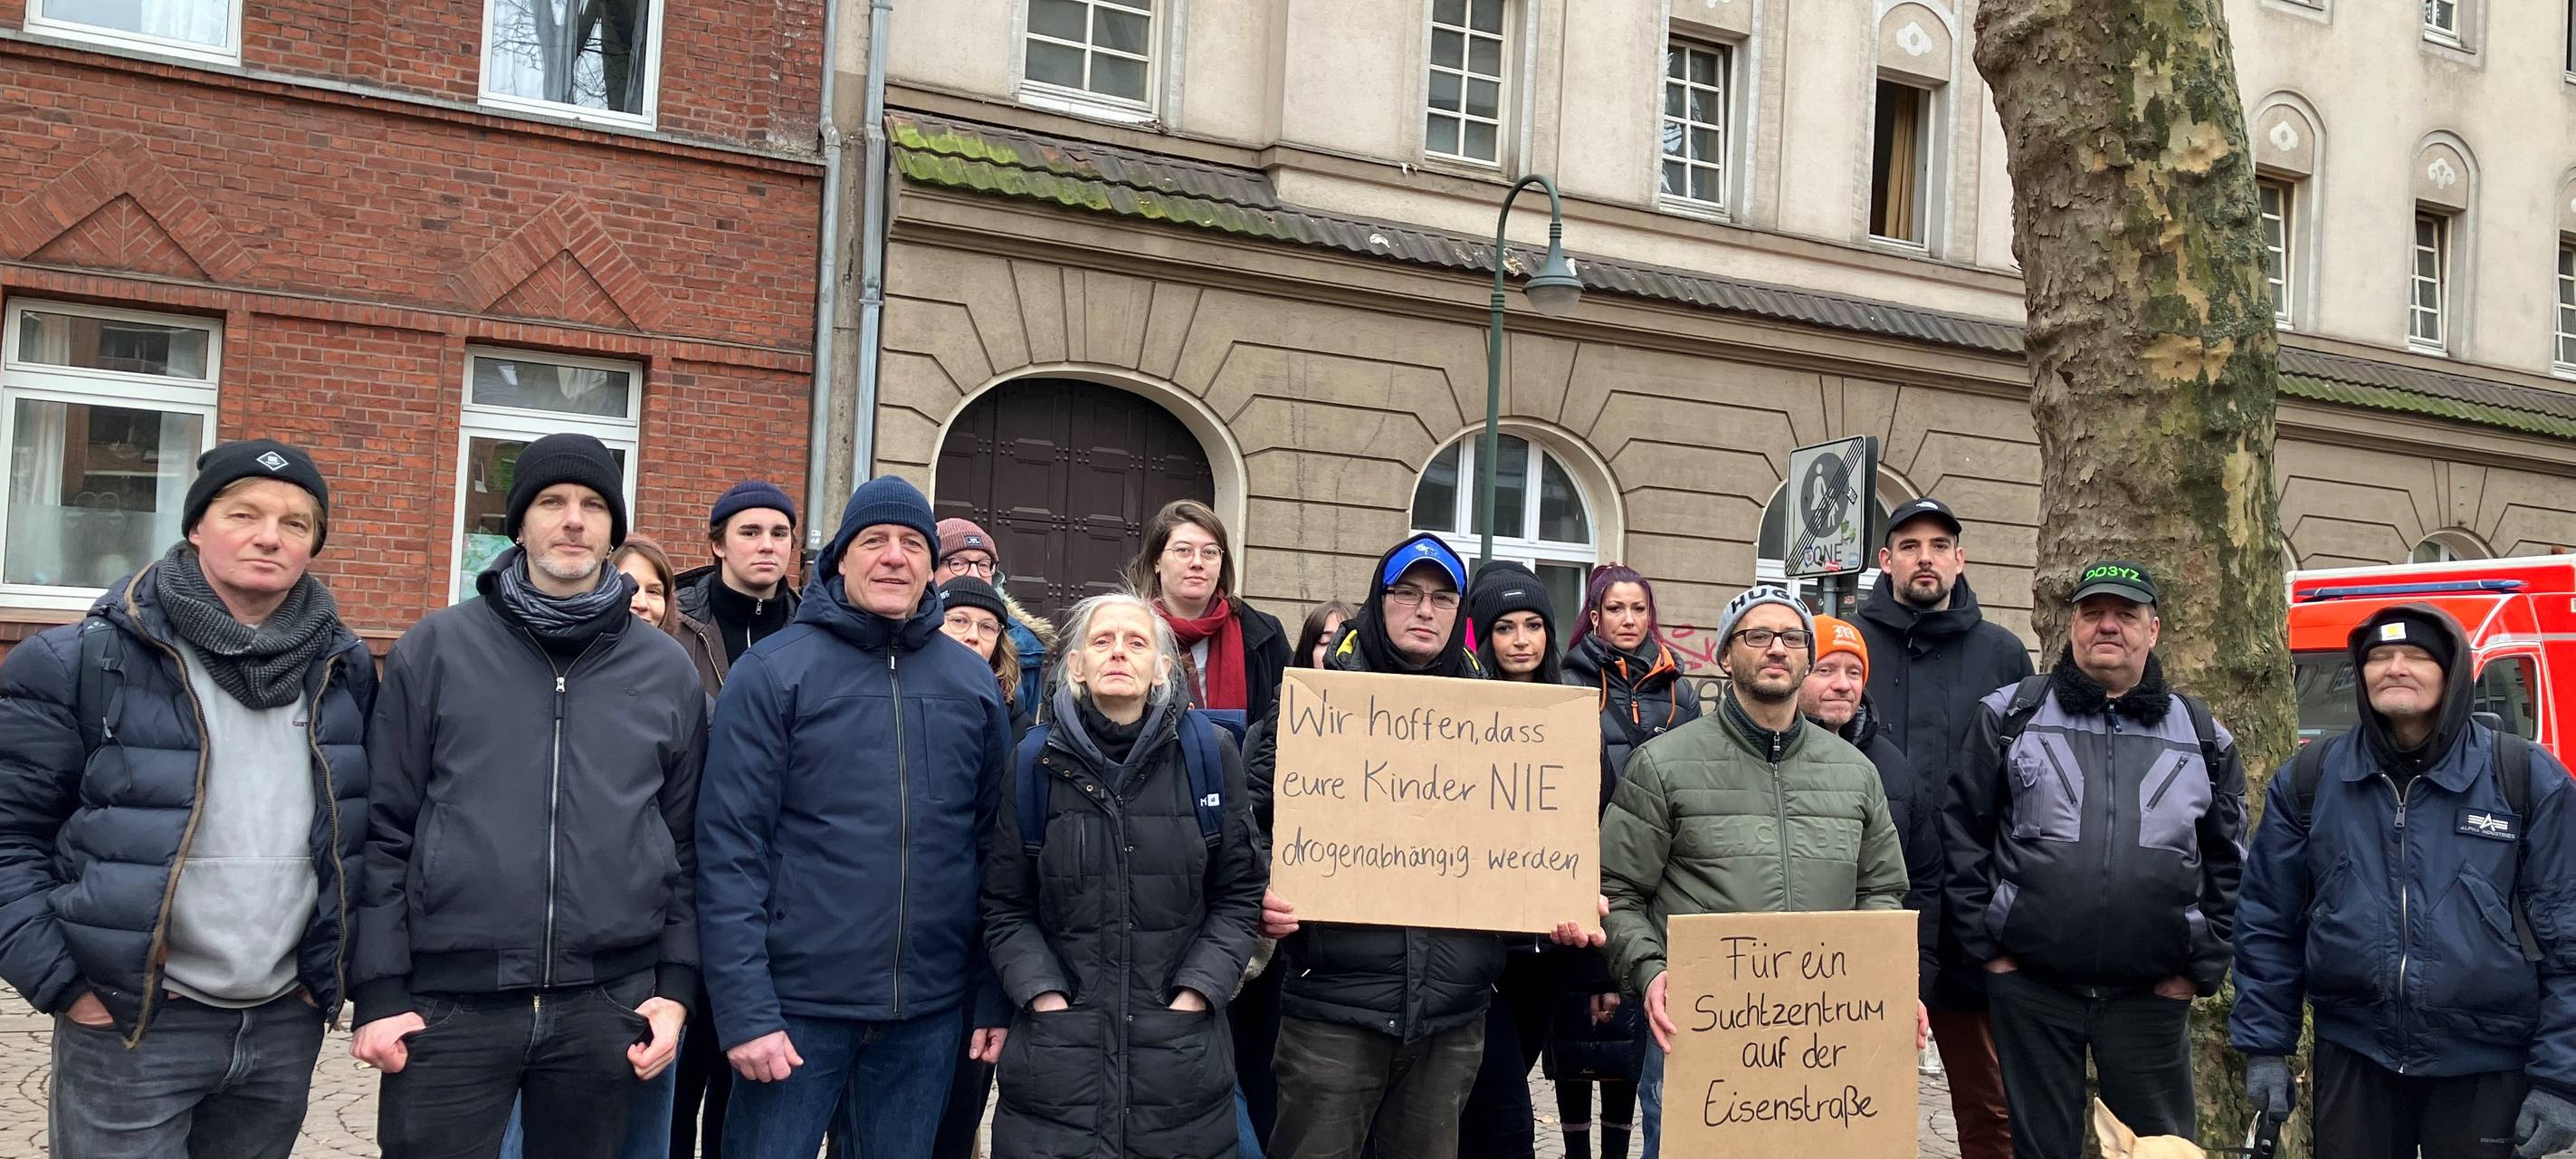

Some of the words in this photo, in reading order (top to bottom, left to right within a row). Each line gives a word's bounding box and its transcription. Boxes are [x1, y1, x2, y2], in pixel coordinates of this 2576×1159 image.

[1806, 543, 1843, 566] ONE
[1732, 588, 1808, 614] HUGO
[1289, 684, 1353, 737] Wir
[1484, 711, 1545, 743] dass
[1283, 770, 1346, 800] eure
[1364, 759, 1476, 803] Kinder
[1490, 763, 1564, 811] NIE
[1282, 826, 1470, 878] drogenabhängig
[1488, 848, 1580, 880] werden
[1720, 936, 1792, 981] Für
[1801, 941, 1846, 980] ein
[1692, 991, 1884, 1032] Suchtzentrum
[1741, 1035, 1789, 1069] auf
[1802, 1032, 1846, 1068] der
[1703, 1079, 1878, 1129] Eisenstraße
